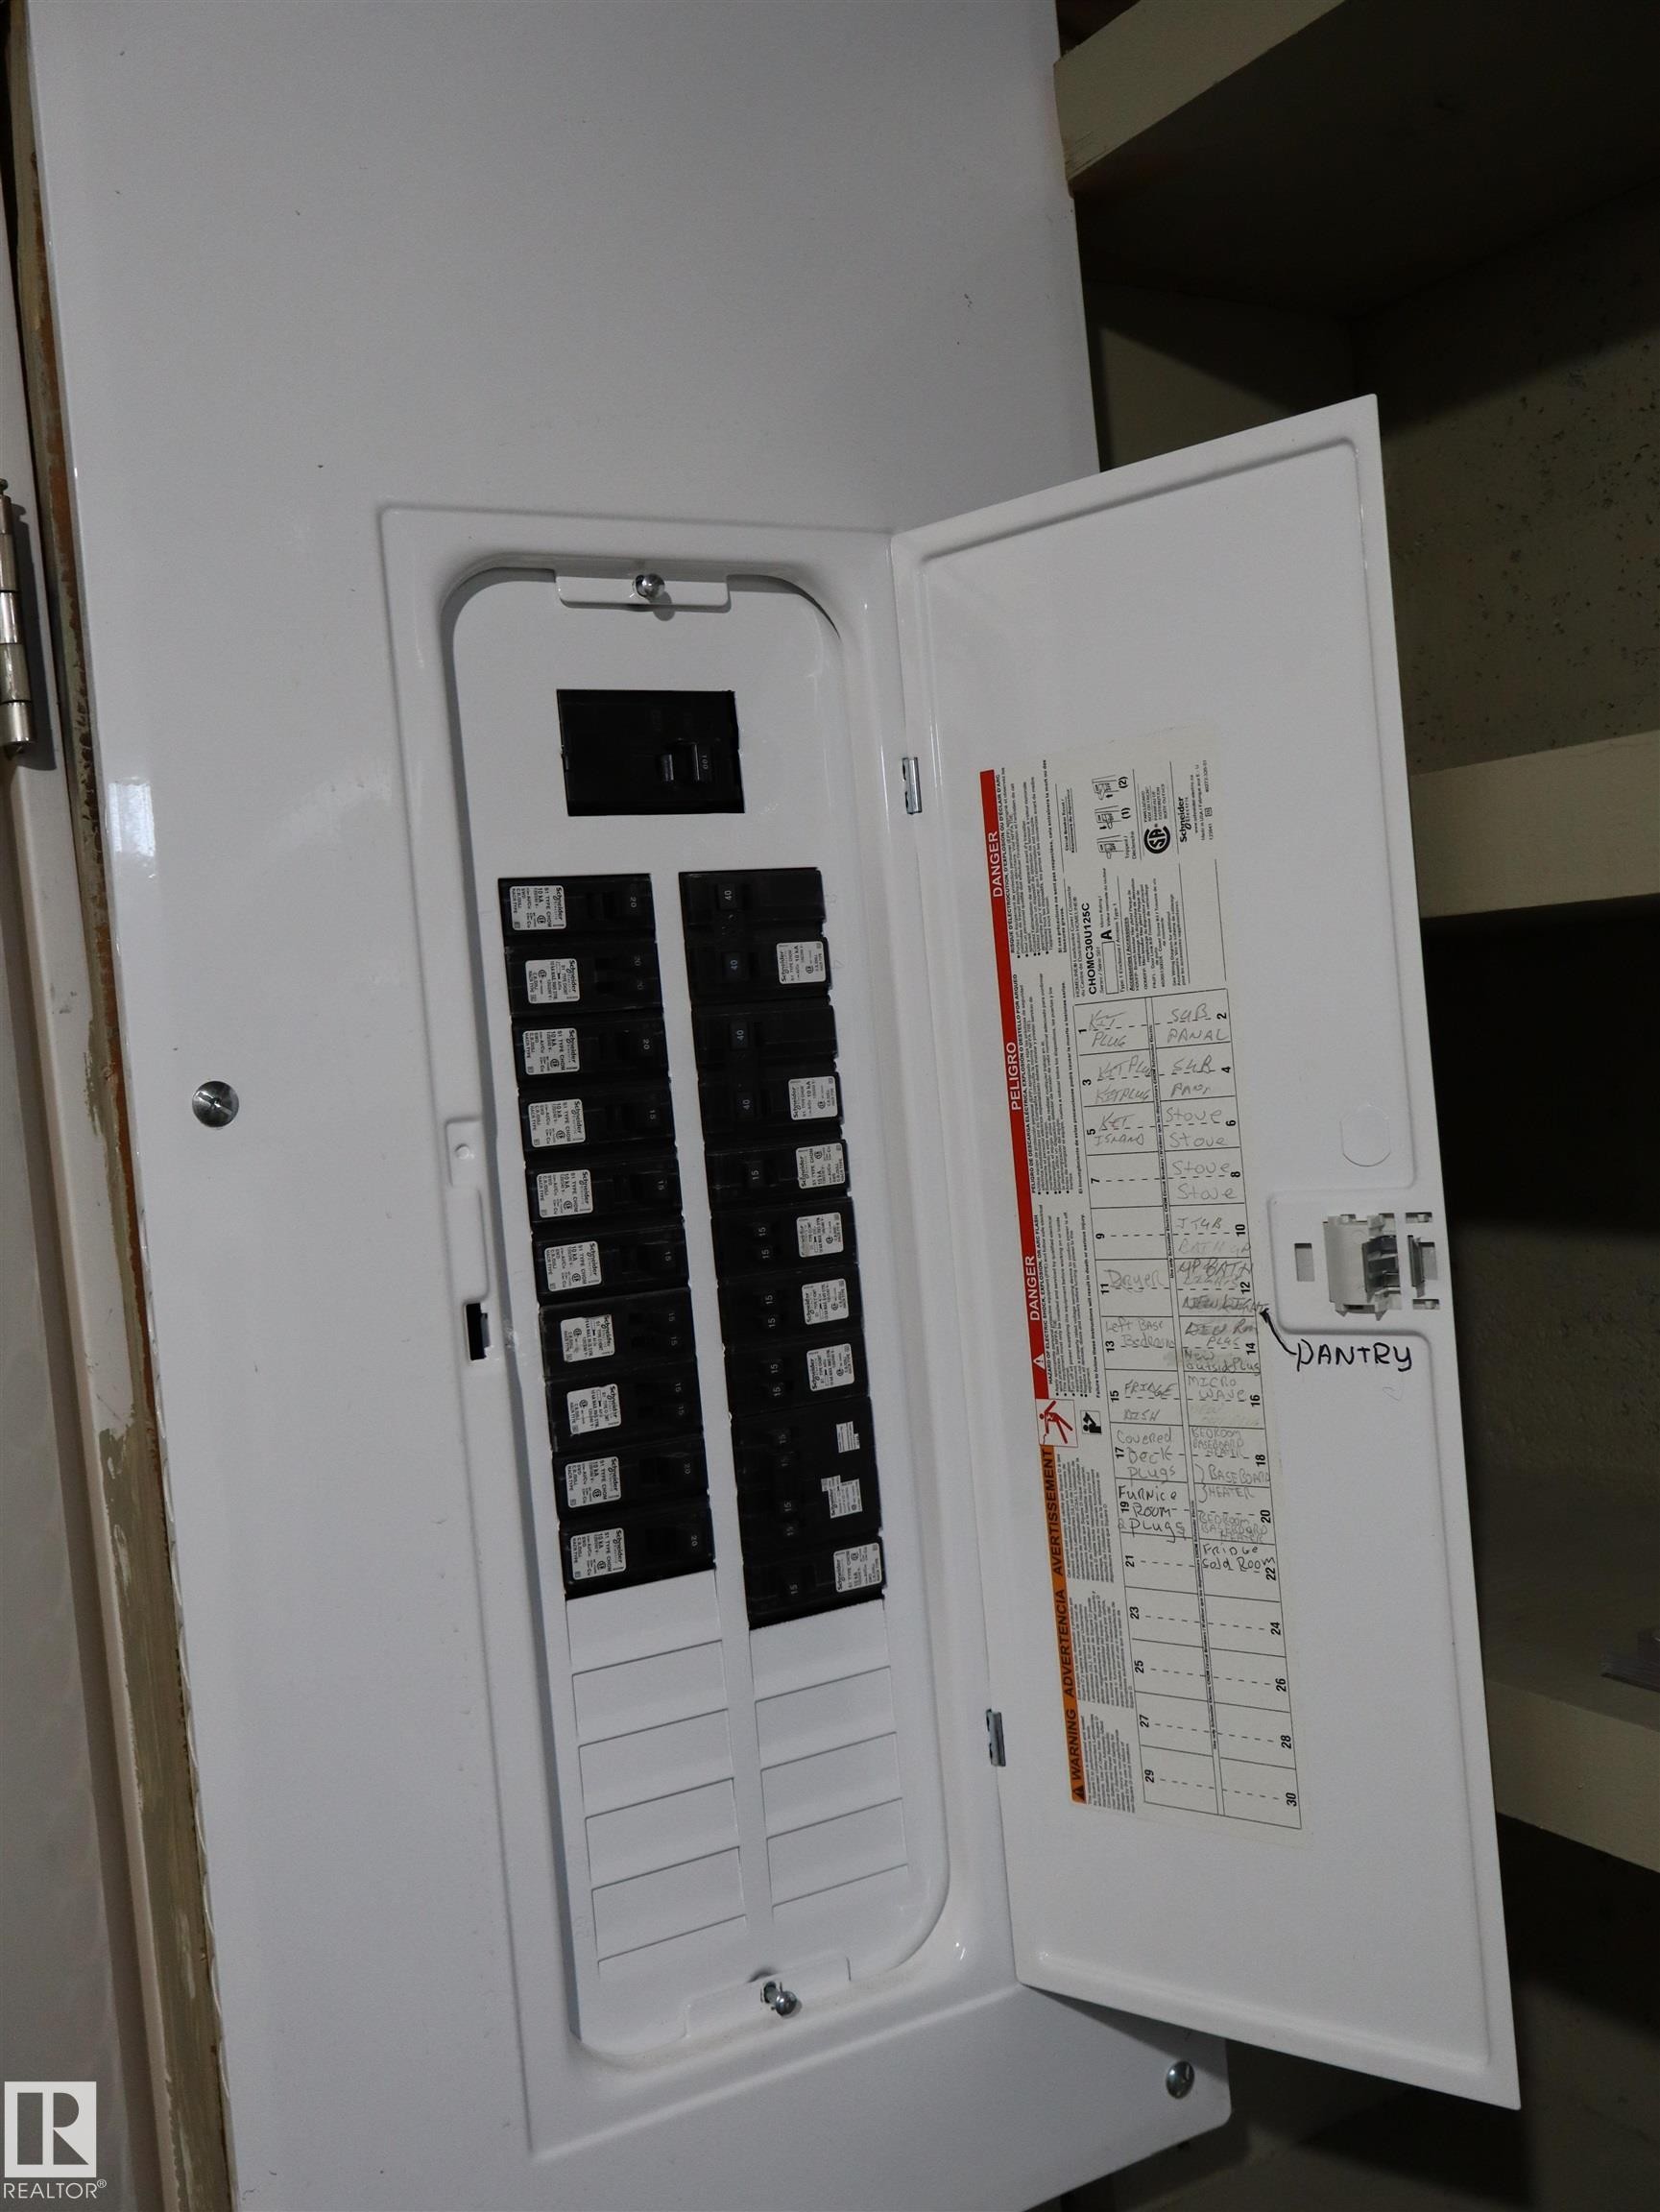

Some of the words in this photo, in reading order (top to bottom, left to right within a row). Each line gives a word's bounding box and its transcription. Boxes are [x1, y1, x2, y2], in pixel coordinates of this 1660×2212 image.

[1117, 775, 1129, 788] (2)
[1119, 805, 1131, 819] (1)
[1178, 796, 1190, 843] Schneider
[988, 830, 1003, 898] DANGER
[629, 897, 638, 908] 20
[724, 890, 733, 901] 40
[553, 887, 565, 920] Schneider
[1101, 928, 1112, 941] A
[1081, 902, 1096, 995] CHOMC30U125C
[731, 959, 738, 971] 40
[780, 950, 789, 982] Schneider
[566, 960, 577, 993] Schneider
[736, 1029, 744, 1041] 40
[1092, 1031, 1127, 1047] PLUG
[1167, 1028, 1229, 1044] PANAL
[566, 1029, 578, 1063] Schneider
[642, 1038, 650, 1049] 20
[1005, 1042, 1022, 1112] PELIGRO
[742, 1099, 751, 1111] 40
[791, 1087, 801, 1118] Schneider
[571, 1100, 583, 1134] Schneider
[649, 1109, 657, 1119] 15
[1166, 1107, 1222, 1123] Stove
[1169, 1132, 1227, 1148] Stove
[752, 1169, 759, 1180] 15
[1172, 1161, 1230, 1175] Stove
[579, 1171, 590, 1204] Schneider
[658, 1180, 665, 1190] 15
[1177, 1183, 1237, 1200] Stove
[758, 1227, 766, 1238] 15
[1235, 1224, 1246, 1237] 10
[587, 1243, 598, 1276] Schneider
[663, 1251, 672, 1262] 15
[761, 1249, 769, 1260] 15
[1025, 1255, 1040, 1322] DANGER
[1100, 1284, 1110, 1295] 11
[1239, 1282, 1251, 1294] 12
[765, 1295, 773, 1305] 15
[768, 1318, 776, 1328] 15
[1105, 1340, 1115, 1353] 13
[1245, 1342, 1256, 1356] 14
[1296, 1338, 1412, 1373] PANTRY
[771, 1364, 779, 1374] 15
[1188, 1375, 1237, 1388] MICRO
[1110, 1390, 1119, 1403] 15
[1250, 1394, 1261, 1407] 16
[1115, 1447, 1124, 1458] 17
[1255, 1454, 1266, 1467] 18
[608, 1457, 619, 1491] Schneider
[1042, 1448, 1063, 1576] AVERTISSEMENT
[1119, 1501, 1129, 1513] 19
[1260, 1509, 1271, 1524] 20
[613, 1529, 624, 1563] Schneider
[1125, 1554, 1135, 1568] 21
[1265, 1567, 1276, 1581] 22
[1130, 1606, 1140, 1620] 23
[1270, 1622, 1281, 1635] 24
[1056, 1589, 1074, 1698] ADVERTENCIA
[1135, 1660, 1144, 1673] 25
[1275, 1678, 1287, 1693] 26
[1140, 1714, 1149, 1728] 27
[1066, 1707, 1083, 1781] WARNING
[1281, 1735, 1292, 1749] 28
[1144, 1769, 1154, 1783] 29
[1286, 1792, 1296, 1807] 30
